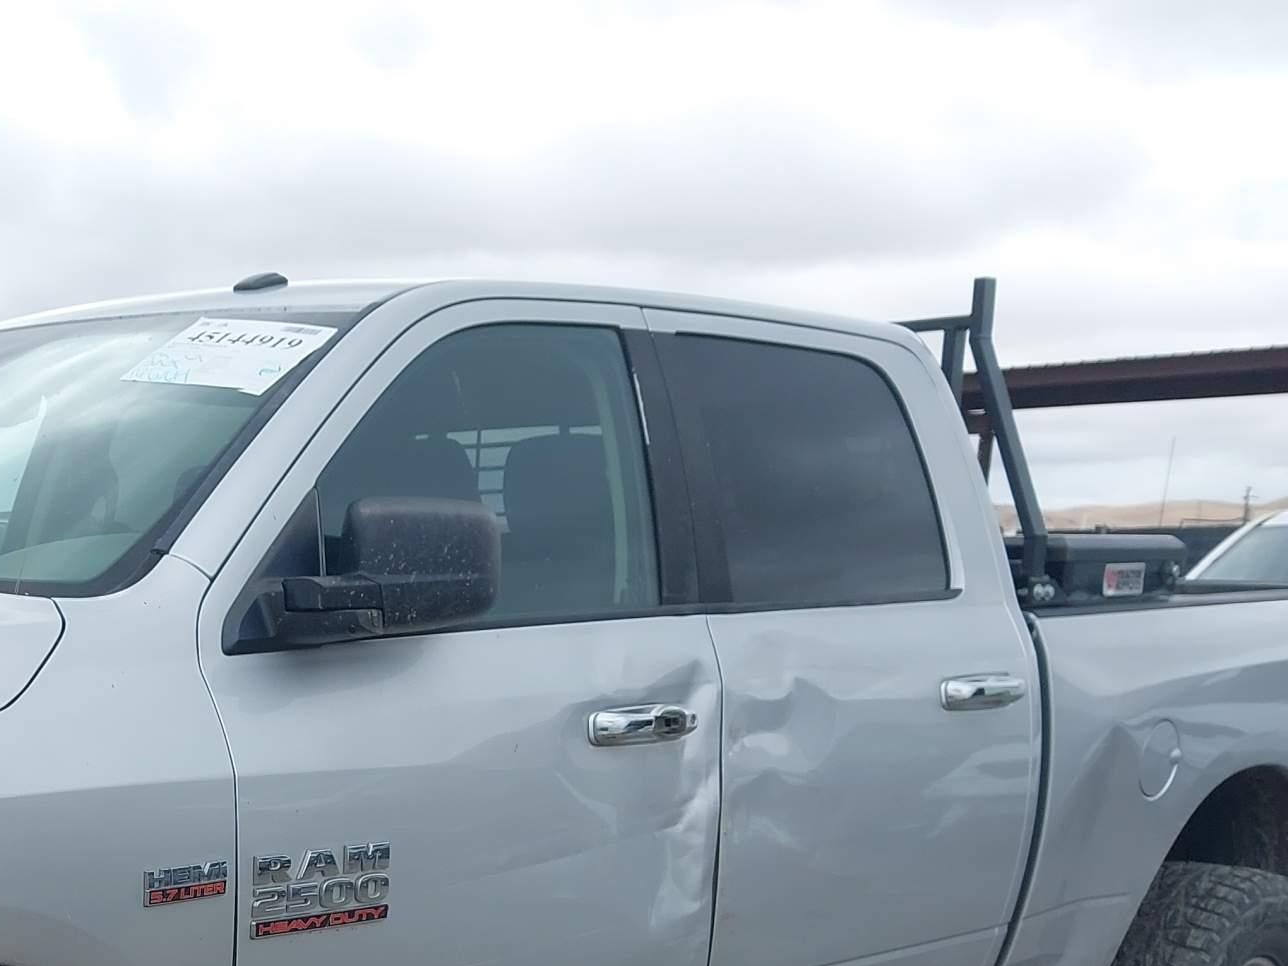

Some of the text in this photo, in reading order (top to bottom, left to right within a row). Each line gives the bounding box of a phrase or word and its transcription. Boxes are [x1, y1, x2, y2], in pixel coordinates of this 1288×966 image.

[188, 331, 304, 348] 45144919
[144, 861, 228, 889] HEMI
[252, 841, 391, 885] RAM
[150, 882, 225, 904] 5.7 LITER
[252, 872, 390, 918] 2500
[258, 906, 387, 936] HEAVY DUTY
